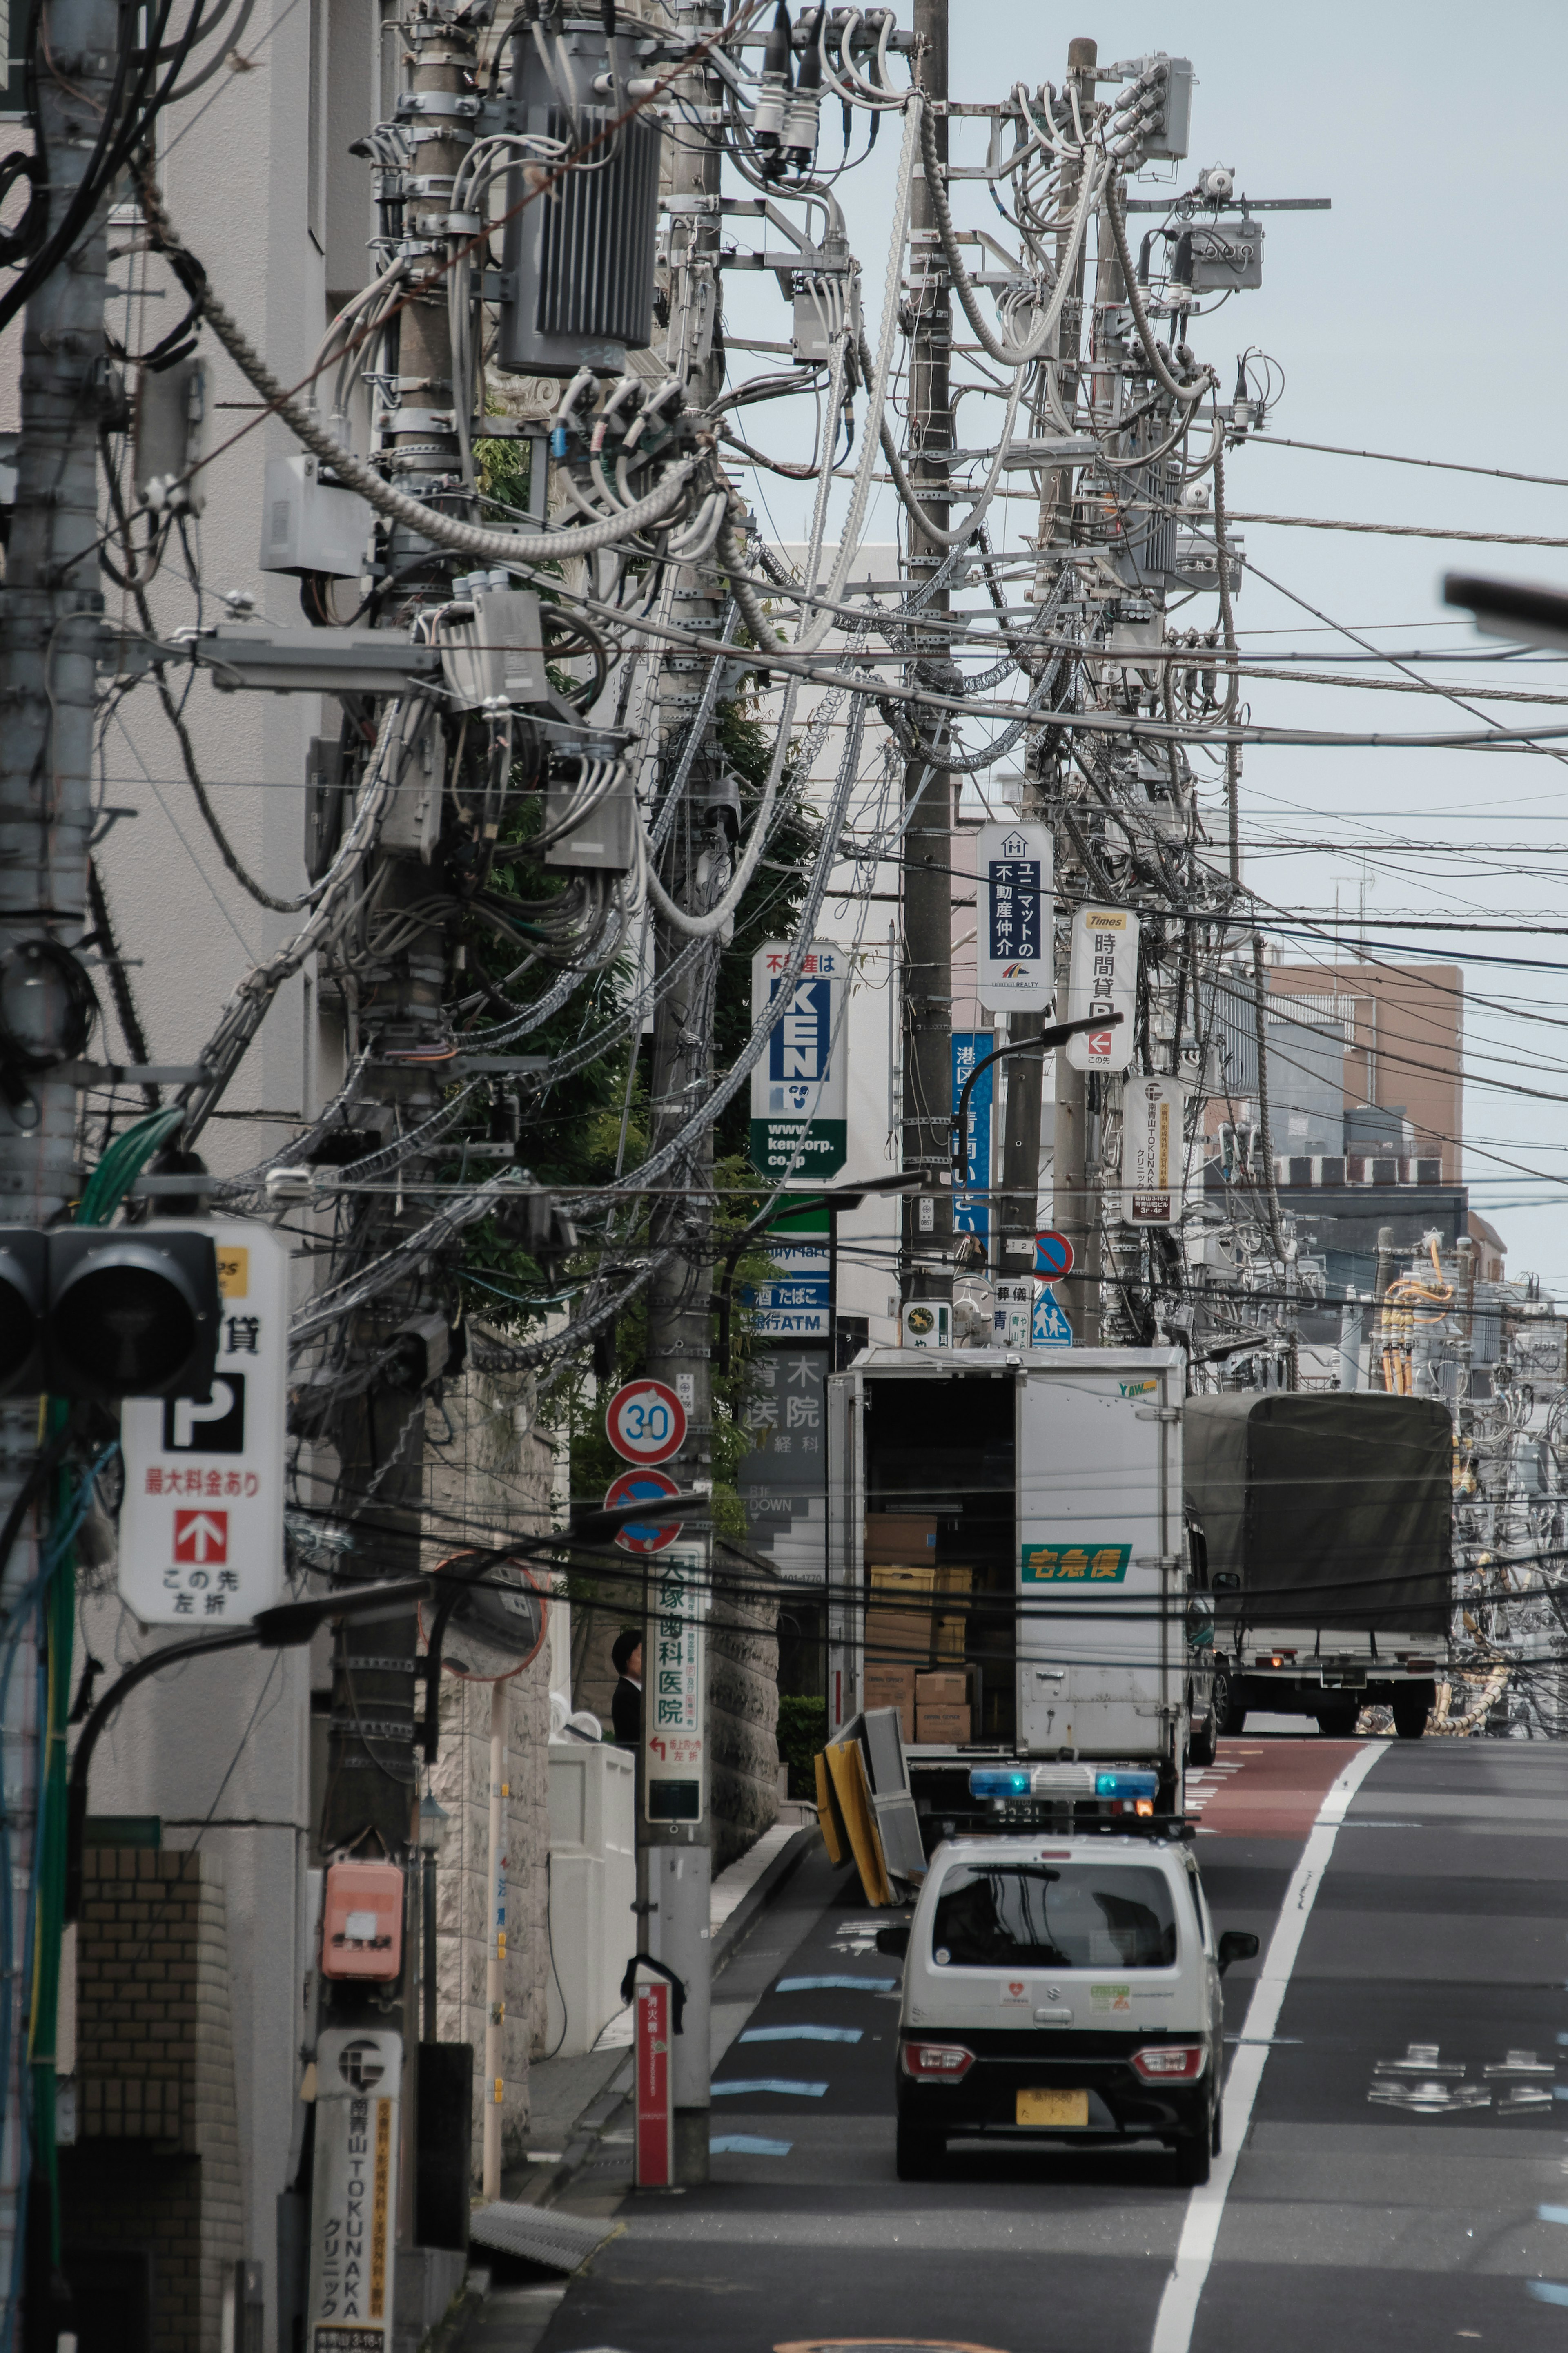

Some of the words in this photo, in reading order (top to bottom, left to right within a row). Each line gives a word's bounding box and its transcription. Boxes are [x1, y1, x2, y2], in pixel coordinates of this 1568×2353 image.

[996, 865, 1013, 955] 不動産仲介
[1018, 863, 1034, 957] ユニマットの
[1090, 916, 1122, 926] Times
[766, 955, 835, 973] 不産は
[784, 983, 817, 1077] KEN
[768, 1125, 813, 1135] www.
[755, 1287, 772, 1306] 酒
[779, 1288, 817, 1305] たばこ
[997, 1287, 1026, 1302] 葬儀
[748, 1355, 819, 1388] 青木
[626, 1405, 668, 1441] 30
[747, 1396, 820, 1429] 医院
[145, 1468, 259, 1497] 最大料金あり
[750, 1499, 791, 1511] DOWN
[1029, 1549, 1114, 1579] 宅急便
[163, 1570, 238, 1592] この先
[658, 1555, 686, 1724] 大塚歯科医院
[648, 1996, 657, 2033] 消火器
[343, 2099, 369, 2318] 南青山TOKUNAKA
[321, 2219, 342, 2318] クリニック
